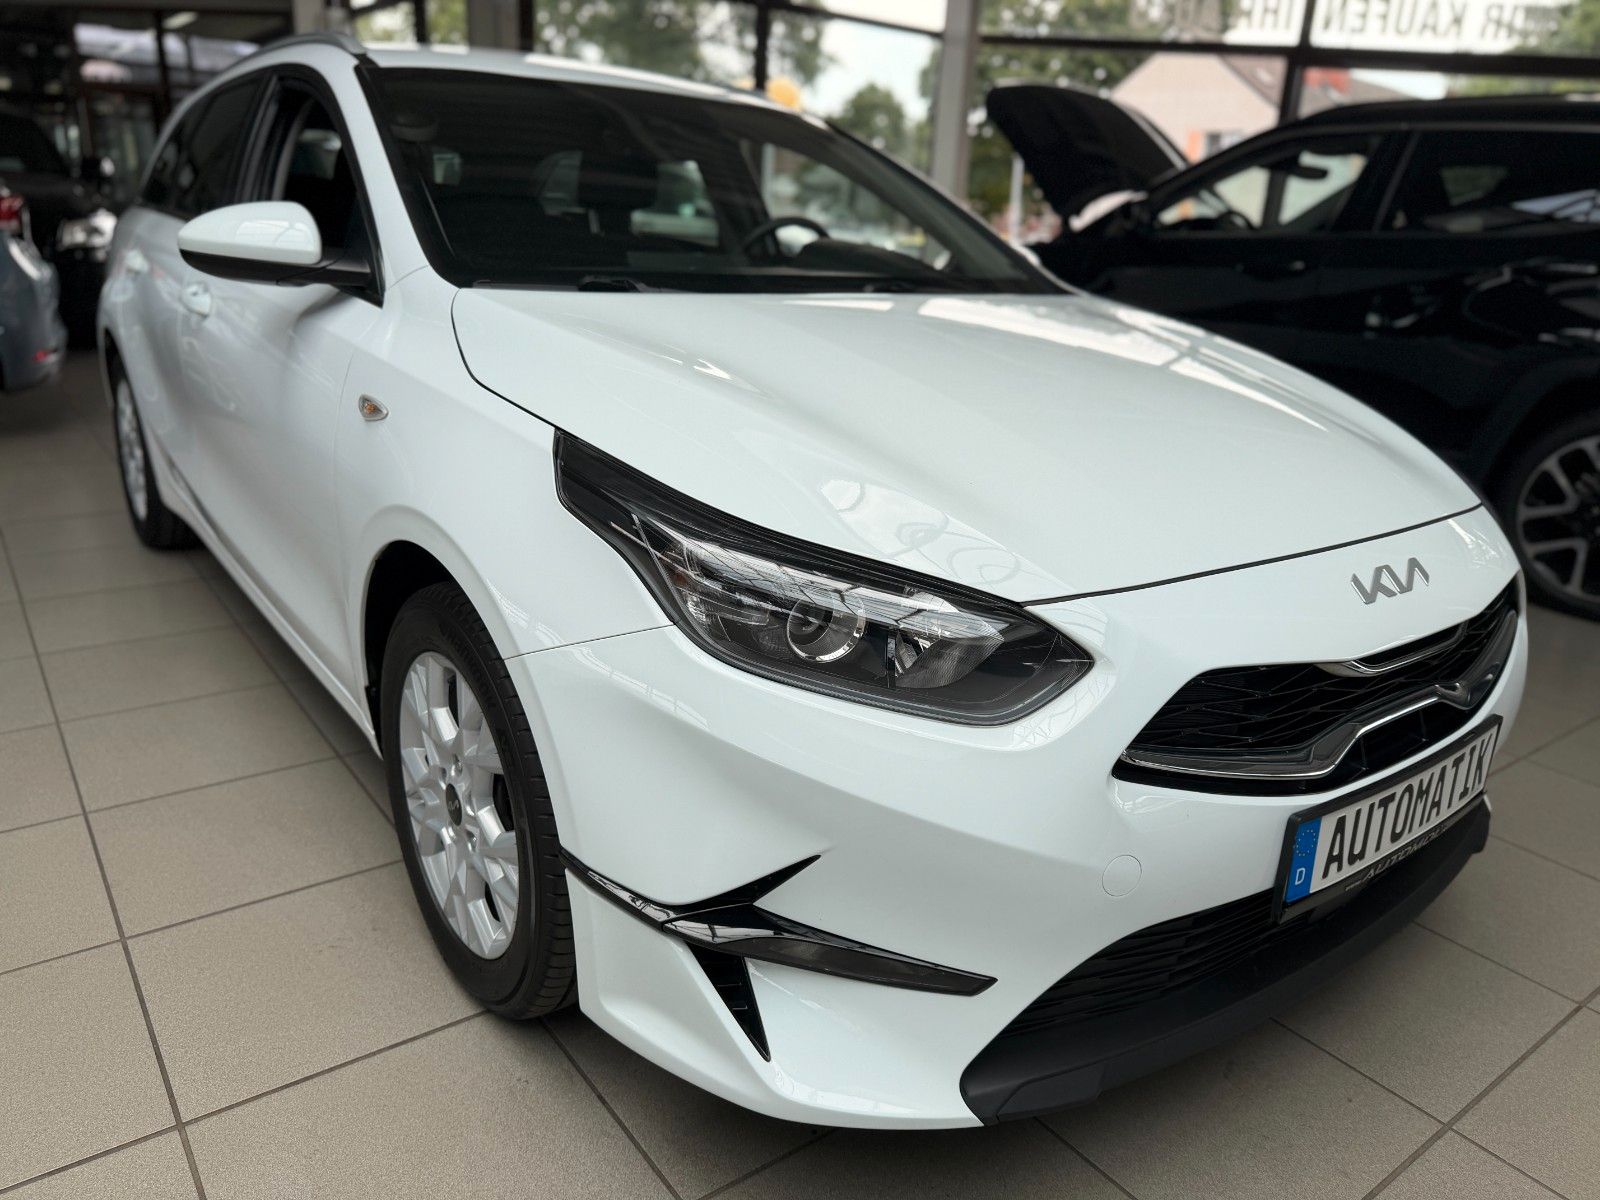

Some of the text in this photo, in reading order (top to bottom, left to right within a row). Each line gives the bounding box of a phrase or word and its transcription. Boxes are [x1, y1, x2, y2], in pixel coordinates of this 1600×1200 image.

[1351, 557, 1430, 605] KIA
[1294, 733, 1493, 886] D AUTOMATIK
